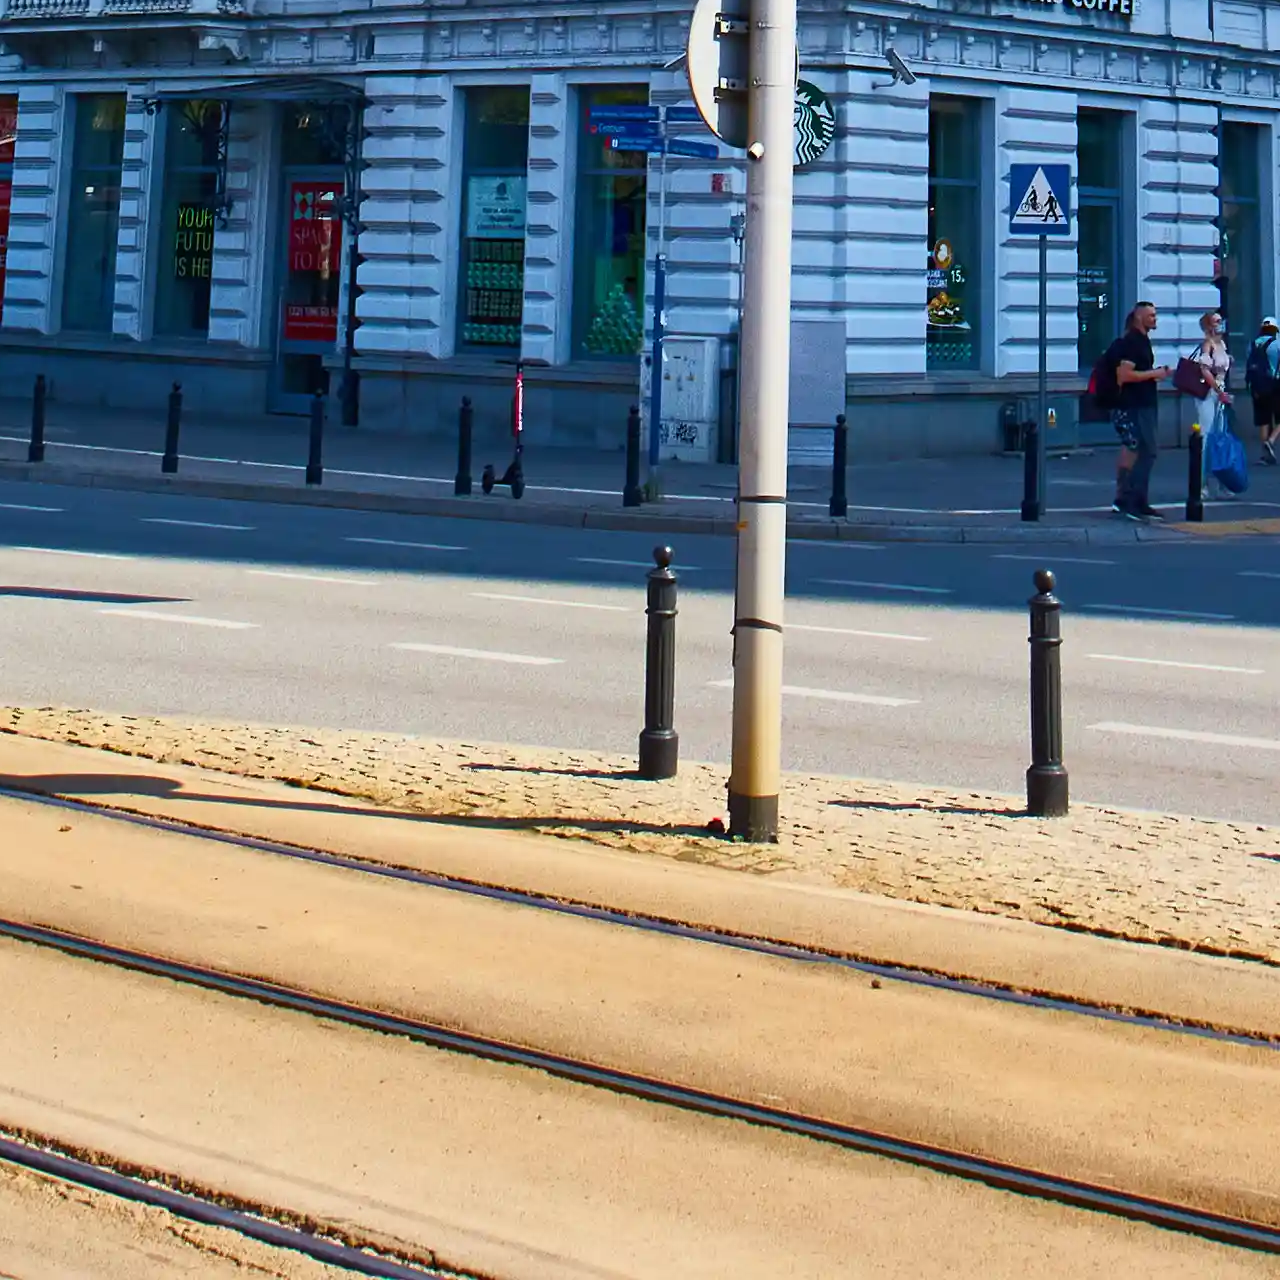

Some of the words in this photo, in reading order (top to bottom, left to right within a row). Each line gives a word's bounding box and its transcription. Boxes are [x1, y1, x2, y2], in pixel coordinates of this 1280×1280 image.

[177, 206, 213, 228] YOUR
[173, 255, 187, 277] IS
[294, 251, 313, 270] TO
